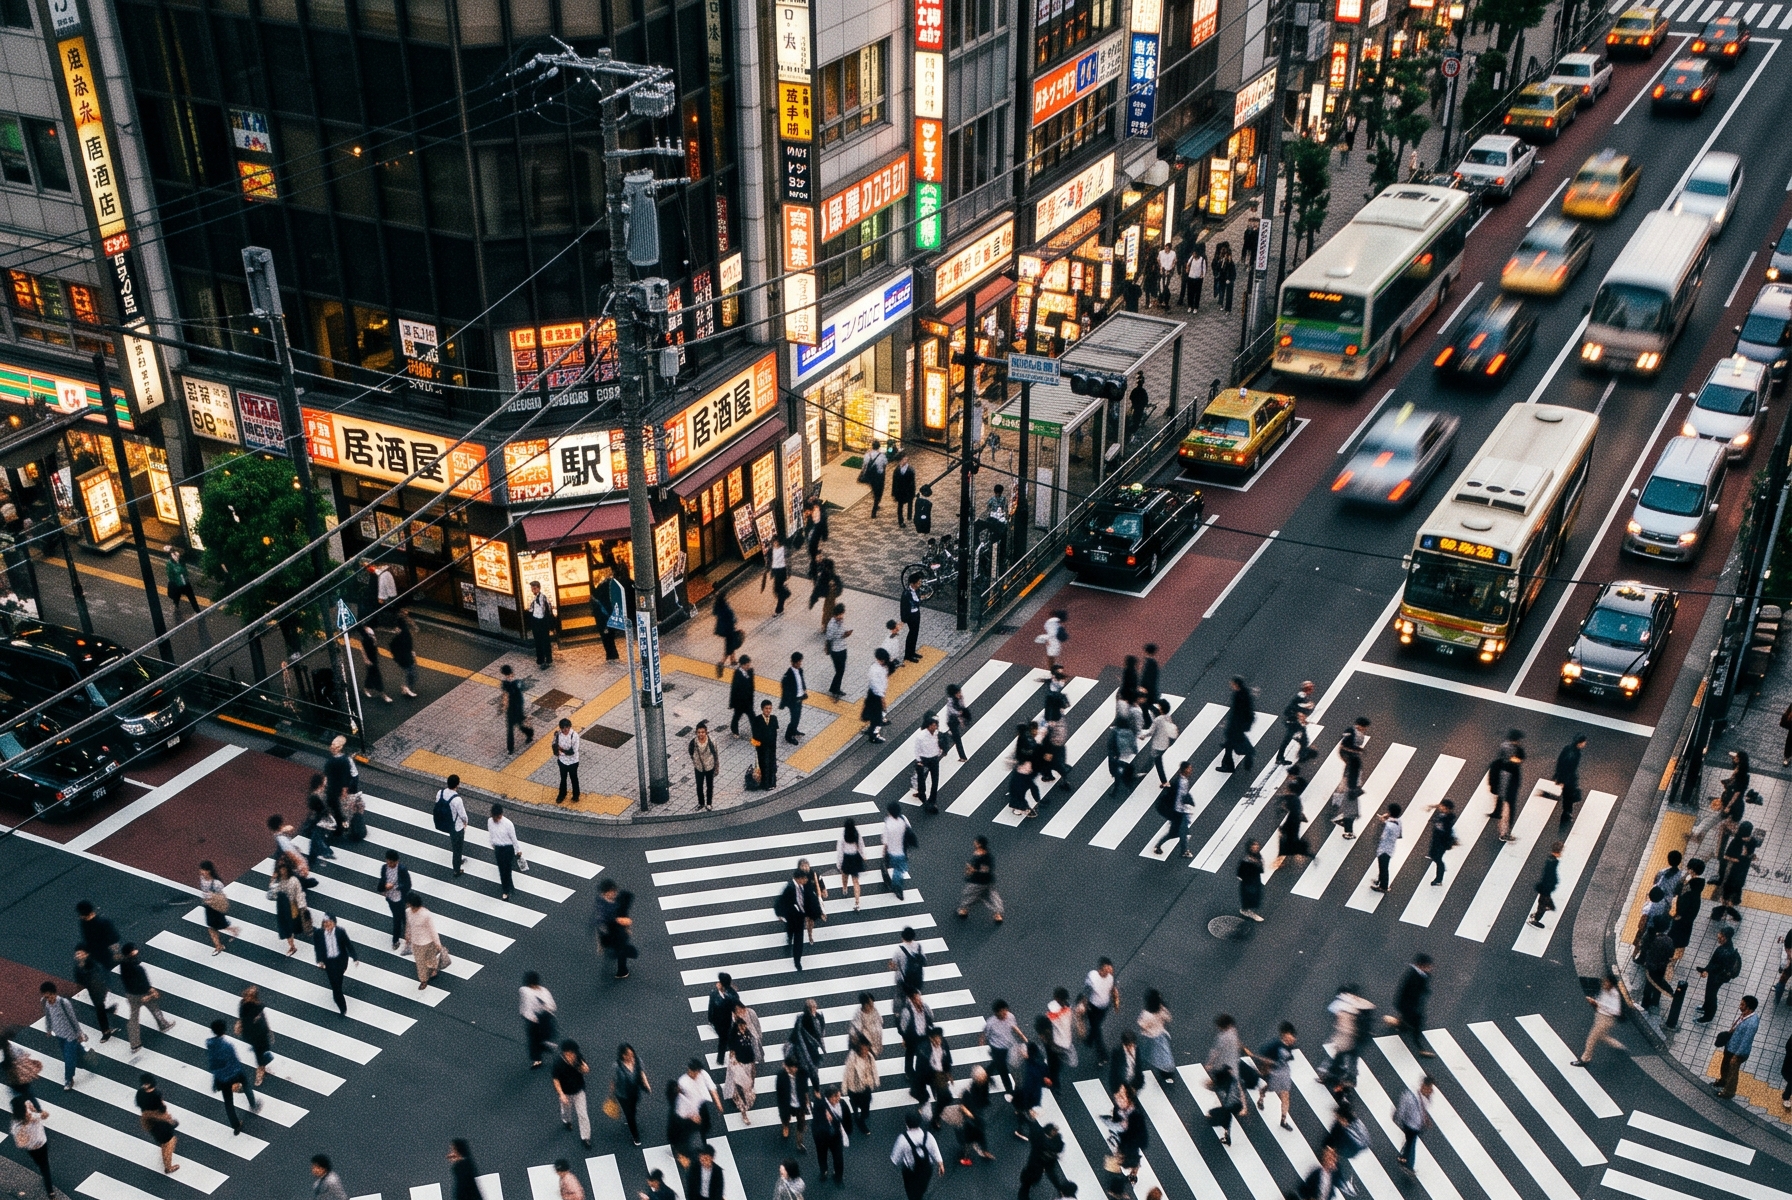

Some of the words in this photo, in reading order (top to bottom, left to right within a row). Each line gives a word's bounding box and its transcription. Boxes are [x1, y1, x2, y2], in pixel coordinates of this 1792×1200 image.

[692, 378, 752, 451] 居酒屋
[342, 426, 444, 483] 居酒屋
[560, 444, 604, 487] 駅
